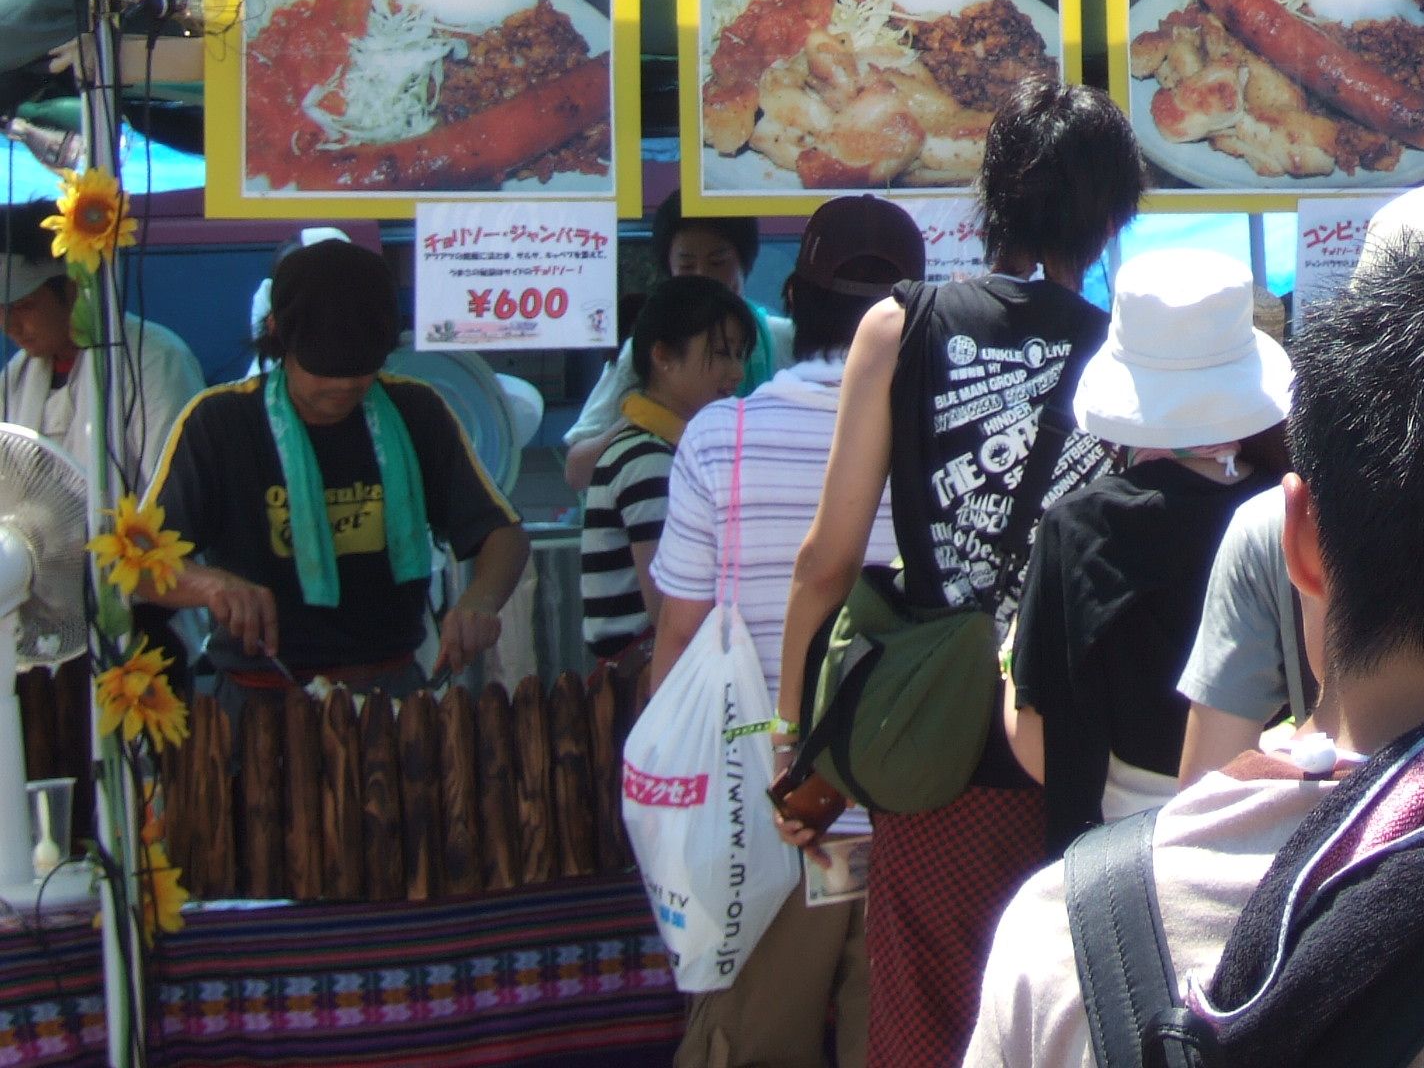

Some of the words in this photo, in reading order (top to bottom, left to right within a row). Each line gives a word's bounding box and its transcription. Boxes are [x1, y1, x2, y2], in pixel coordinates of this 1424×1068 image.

[467, 287, 569, 321] ¥600
[981, 346, 1024, 363] UNKLE
[958, 381, 989, 401] MAN
[989, 368, 1028, 391] GROUP
[982, 401, 1033, 436] HINDER
